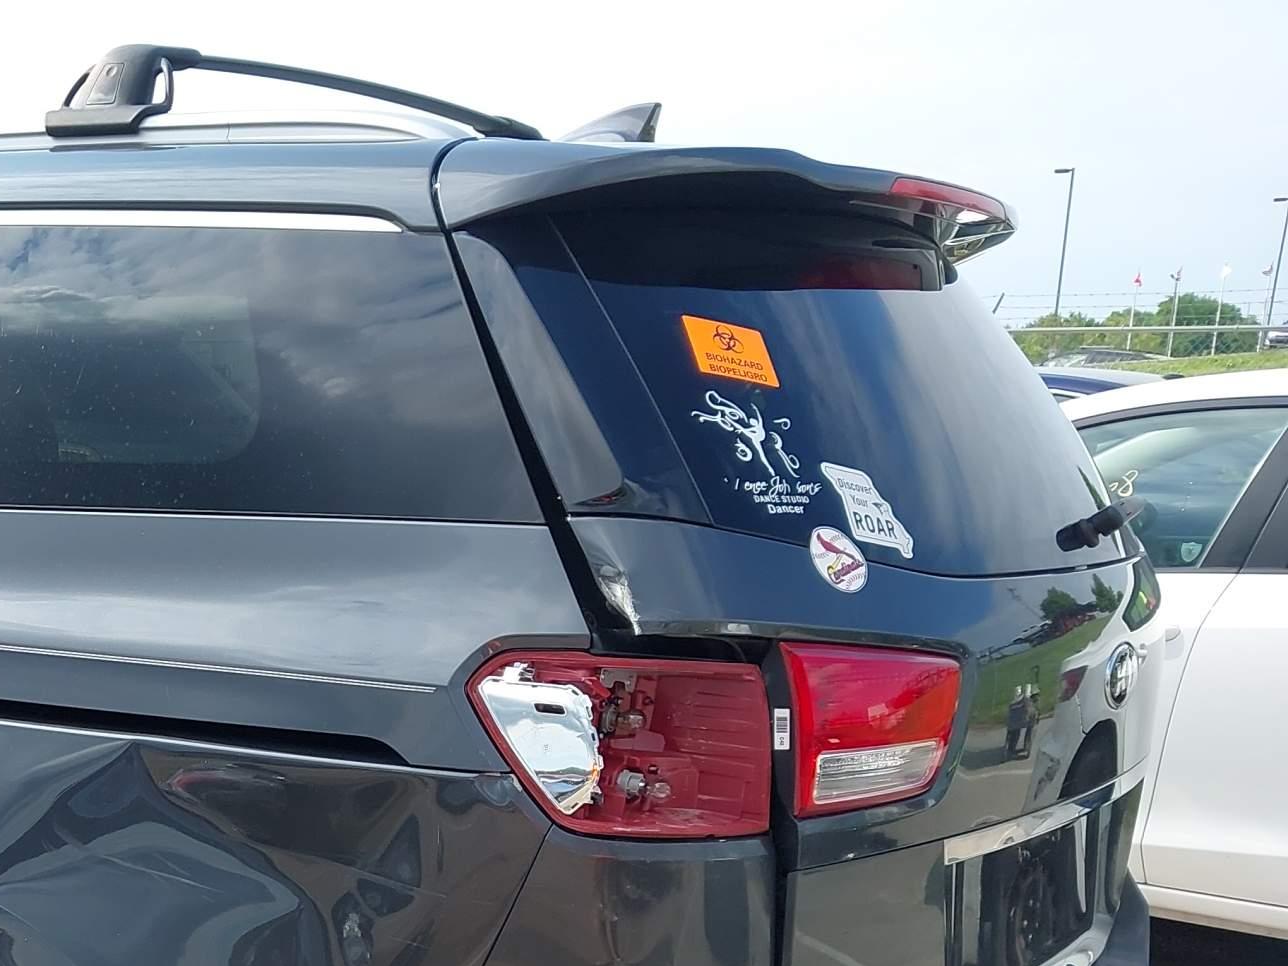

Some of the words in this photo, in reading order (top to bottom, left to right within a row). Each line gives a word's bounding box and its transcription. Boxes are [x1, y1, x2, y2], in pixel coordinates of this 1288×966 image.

[705, 352, 763, 370] BIOHAZARD
[708, 363, 767, 382] BIOPELIGRO
[836, 477, 872, 495] Discover
[753, 494, 781, 503] DANCE
[782, 494, 810, 504] STUDIO
[850, 494, 869, 508] Your
[767, 503, 804, 514] Dancer
[853, 511, 898, 540] ROAR
